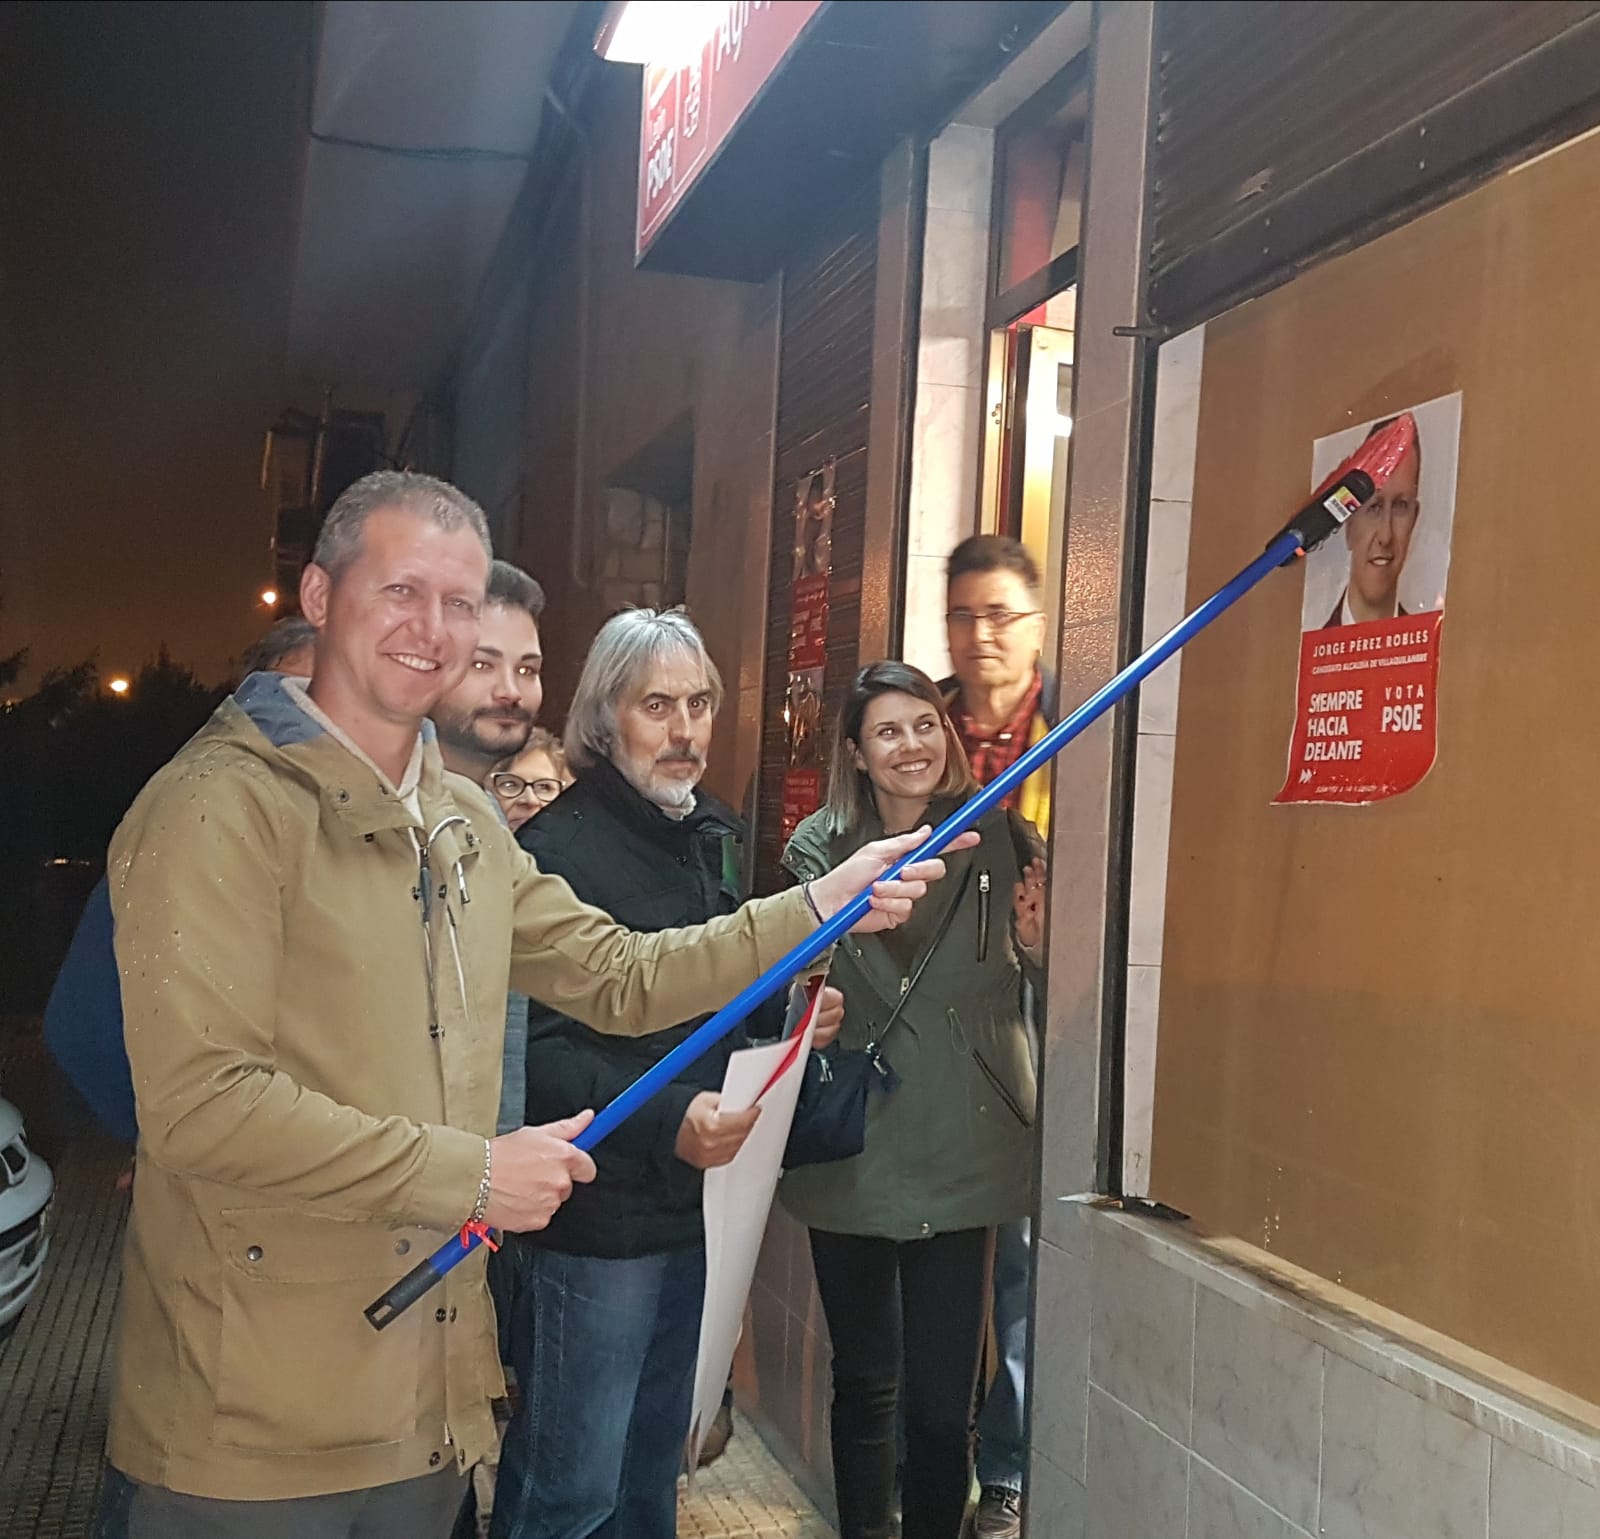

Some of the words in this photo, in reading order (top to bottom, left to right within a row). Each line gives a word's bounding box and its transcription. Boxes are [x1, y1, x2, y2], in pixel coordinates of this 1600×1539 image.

[645, 127, 675, 208] PSOE
[1313, 642, 1345, 657] JORGE
[1349, 637, 1382, 652] PÉREZ
[1386, 630, 1428, 647] ROBLES
[1370, 660, 1377, 668] DE
[1308, 689, 1364, 713] SIEMPRE
[1385, 683, 1425, 701] VOTA
[1307, 716, 1349, 737] HACIA
[1380, 703, 1424, 733] PSOE
[1303, 739, 1364, 762] DELANTE
